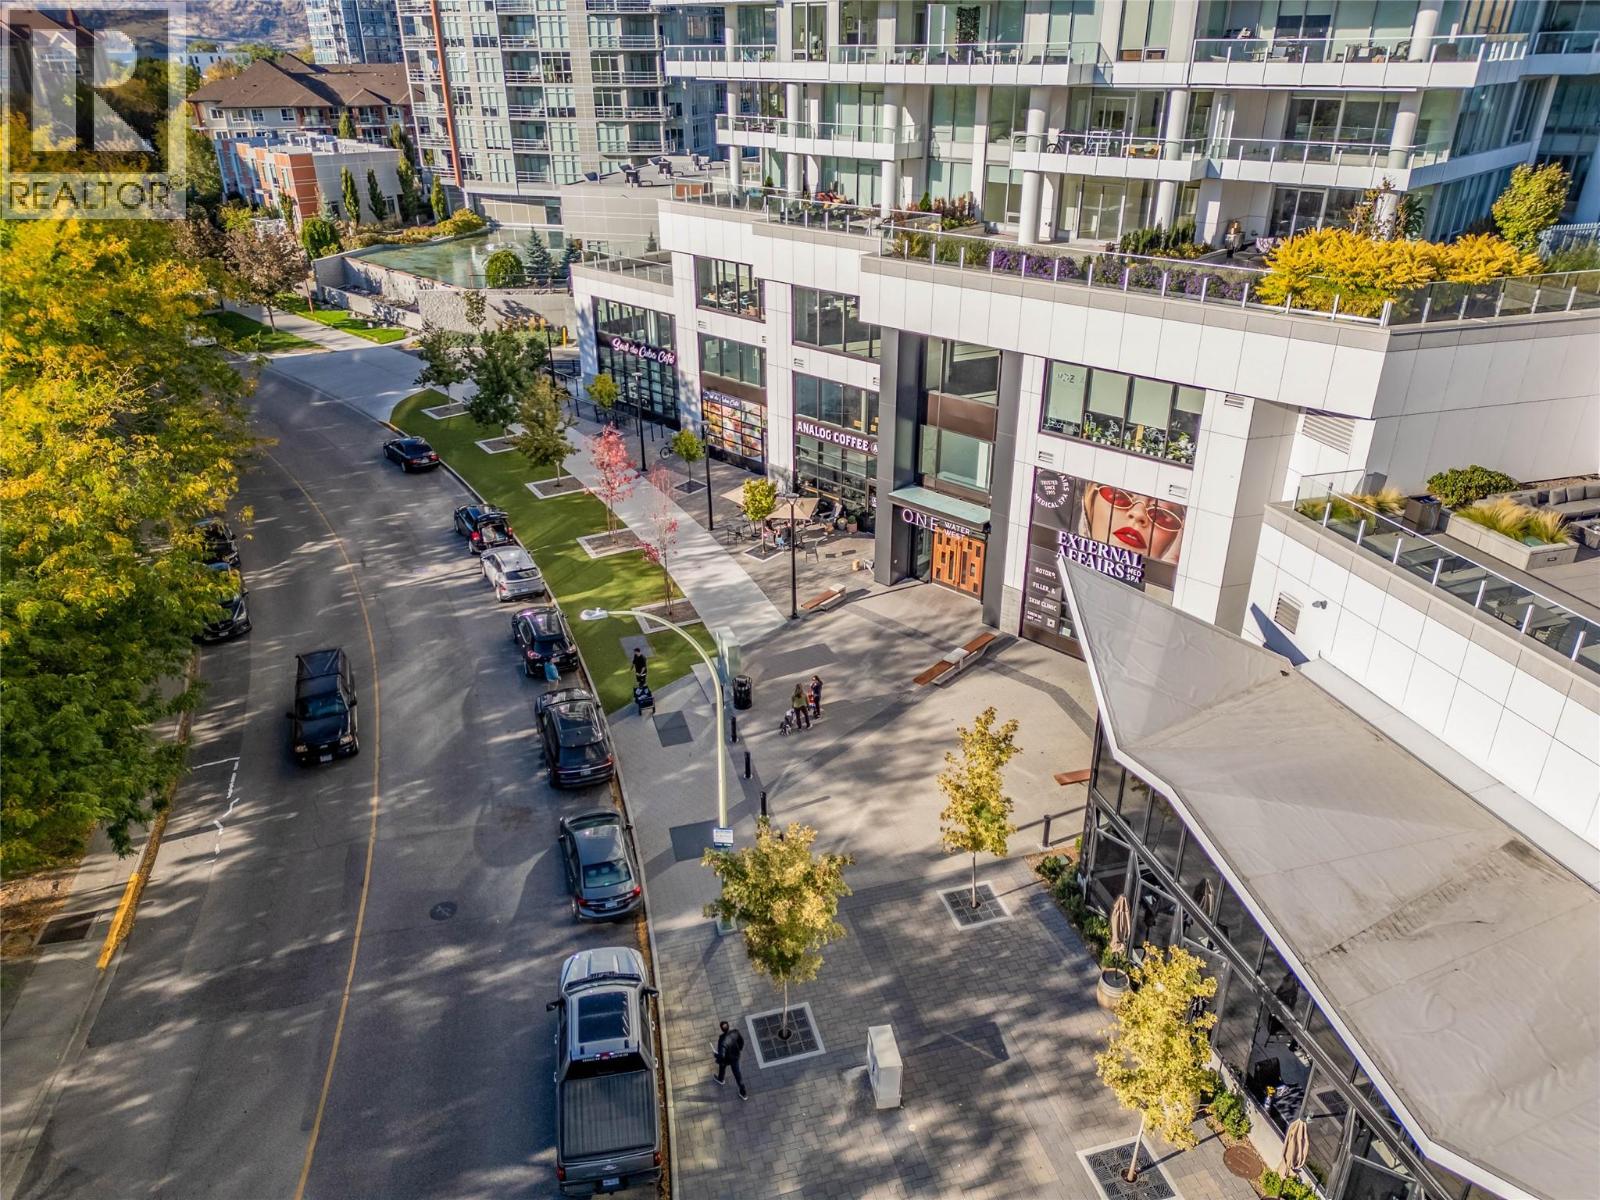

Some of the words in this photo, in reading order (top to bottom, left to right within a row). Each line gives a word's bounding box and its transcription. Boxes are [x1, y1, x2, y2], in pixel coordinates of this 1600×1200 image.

[796, 421, 831, 440] ANALOG
[833, 433, 868, 451] COFFEE
[1034, 493, 1059, 509] MEDICAL
[1058, 493, 1069, 506] SPA
[902, 508, 939, 531] ONE
[944, 521, 970, 535] WATER
[944, 529, 966, 540] WEST
[1057, 530, 1143, 569] EXTERNAL
[1056, 545, 1125, 579] AFFAIRS
[1126, 574, 1140, 583] SPA
[1127, 566, 1142, 577] MED
[1032, 581, 1051, 593] FILLER,
[1028, 596, 1041, 606] SKIN
[1041, 601, 1057, 612] CLINIC
